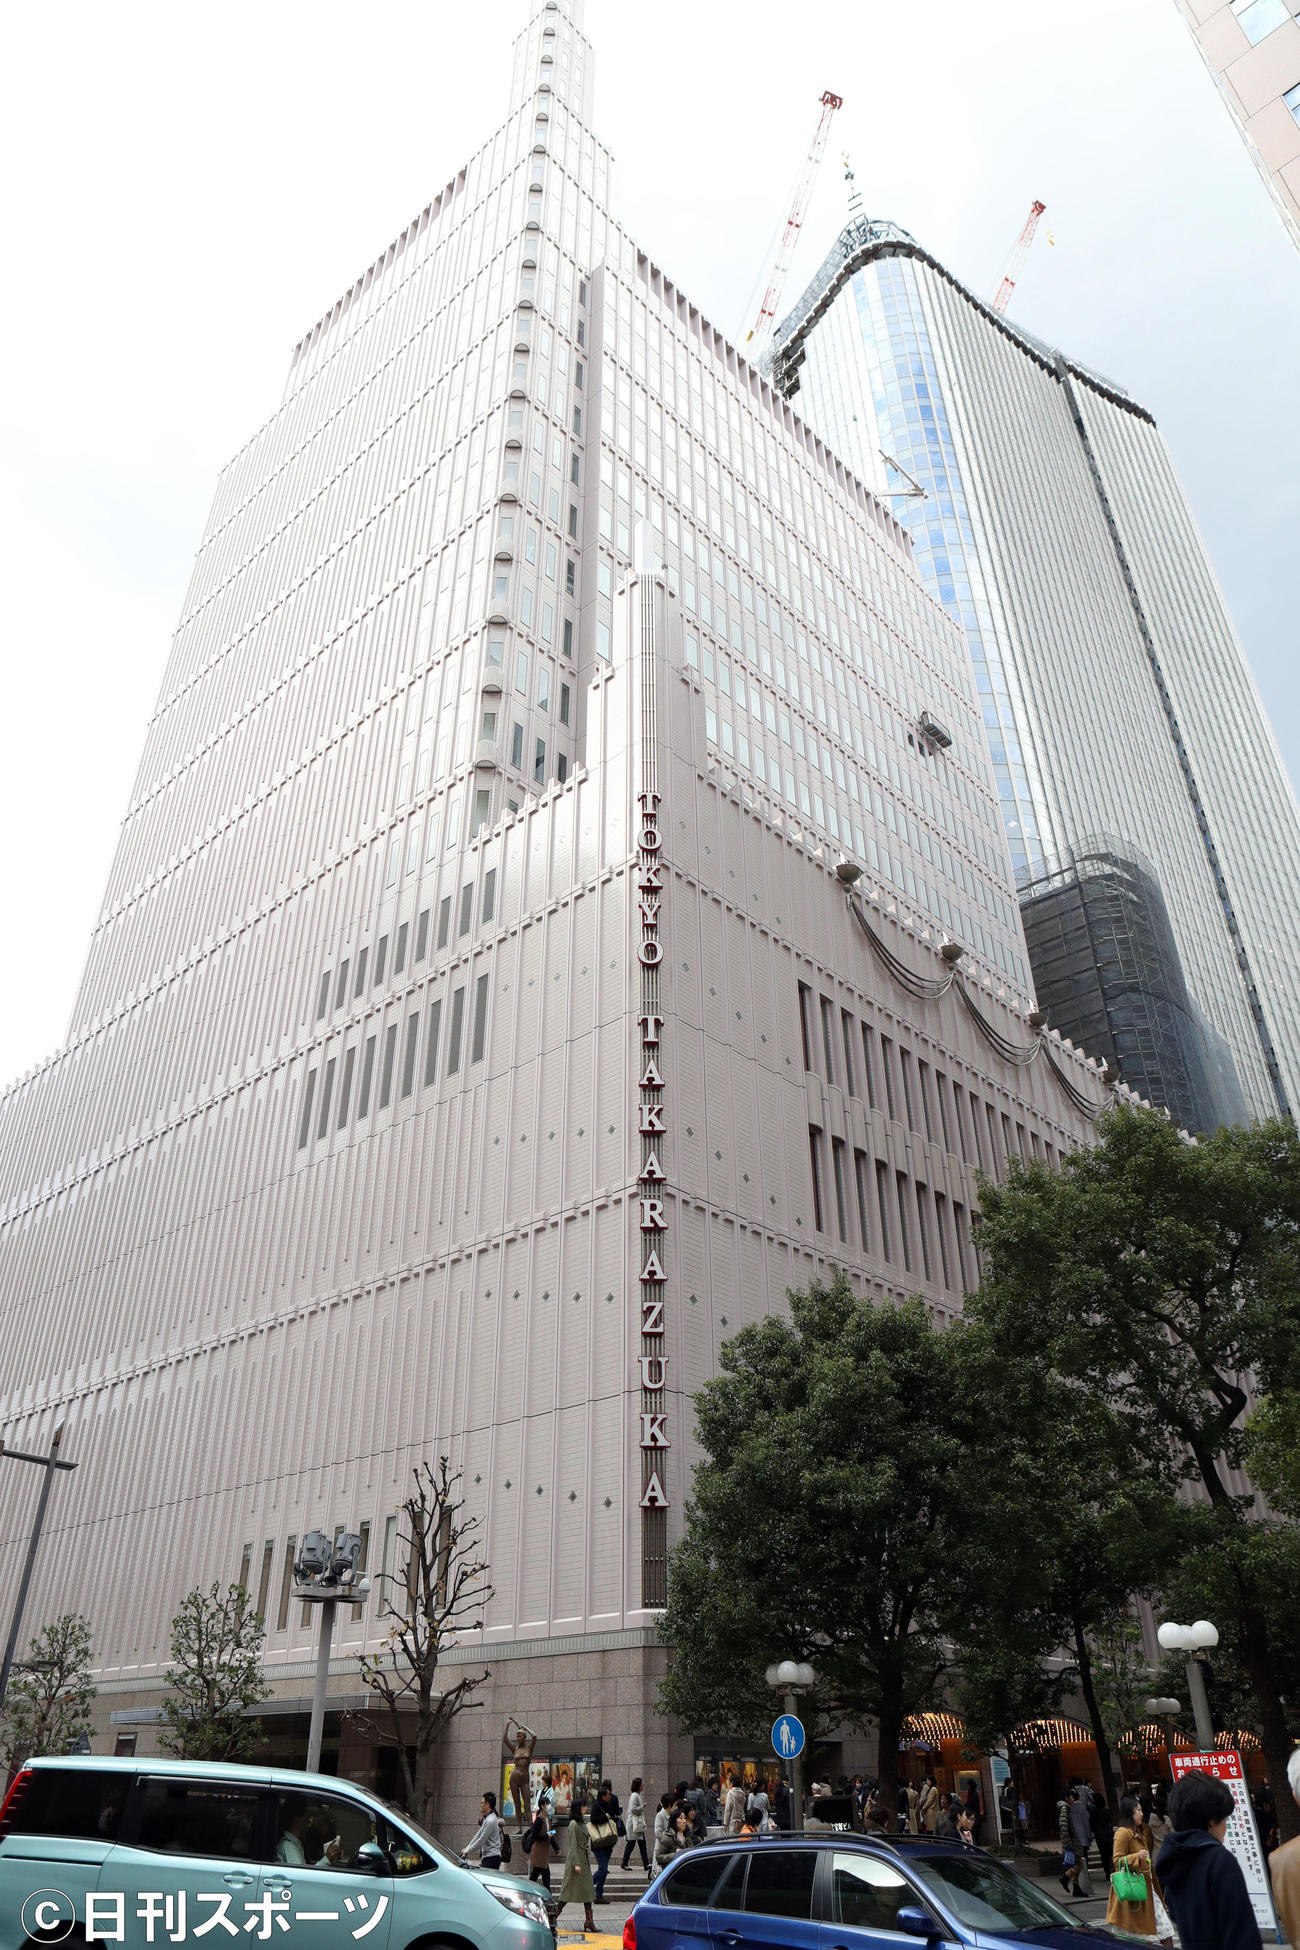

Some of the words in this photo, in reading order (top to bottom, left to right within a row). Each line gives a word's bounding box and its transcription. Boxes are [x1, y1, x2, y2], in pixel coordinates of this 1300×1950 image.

[637, 791, 664, 968] TOKYO
[637, 1015, 672, 1508] TAKARAZUKA
[1174, 1755, 1235, 1768] 車両通行止めの
[1176, 1766, 1238, 1779] おらせ
